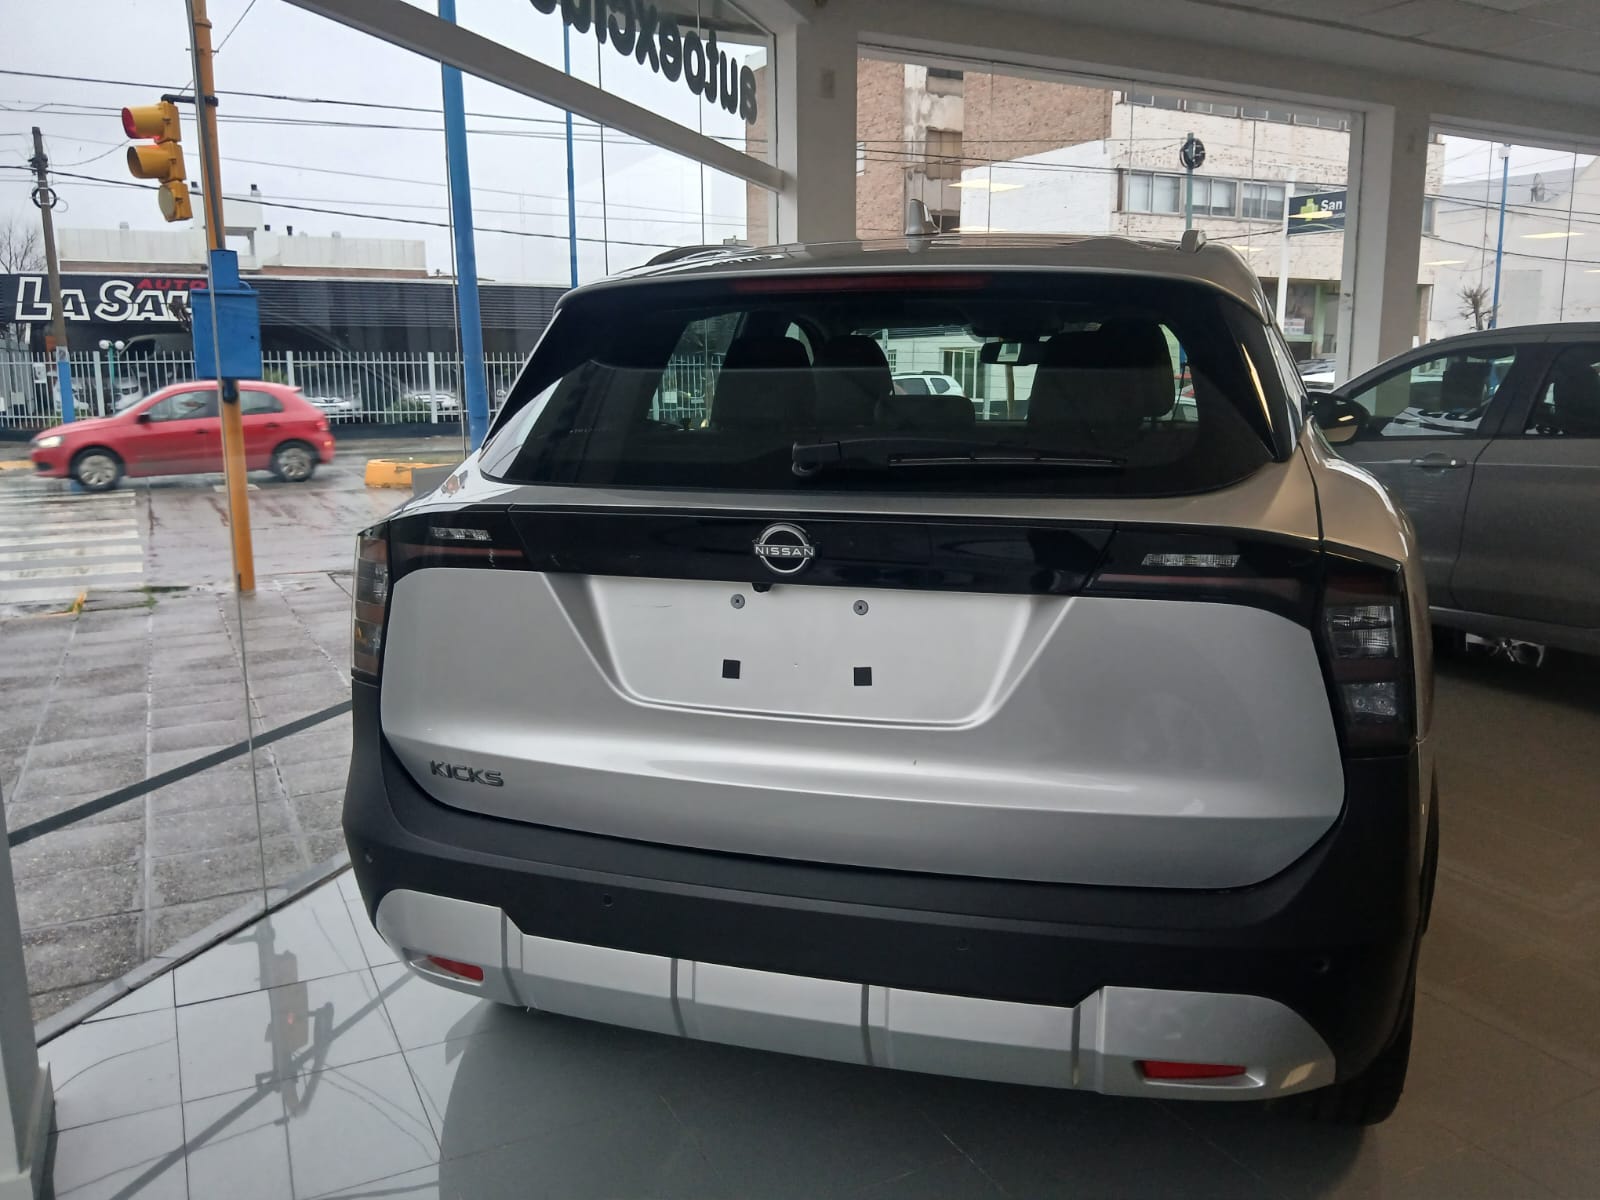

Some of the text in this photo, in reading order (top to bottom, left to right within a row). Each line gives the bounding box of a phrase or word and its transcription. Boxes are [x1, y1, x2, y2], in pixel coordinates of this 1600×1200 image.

[1320, 199, 1343, 211] San
[136, 278, 208, 290] AUTO
[754, 546, 815, 557] NISSAN
[430, 760, 504, 787] KICKS
